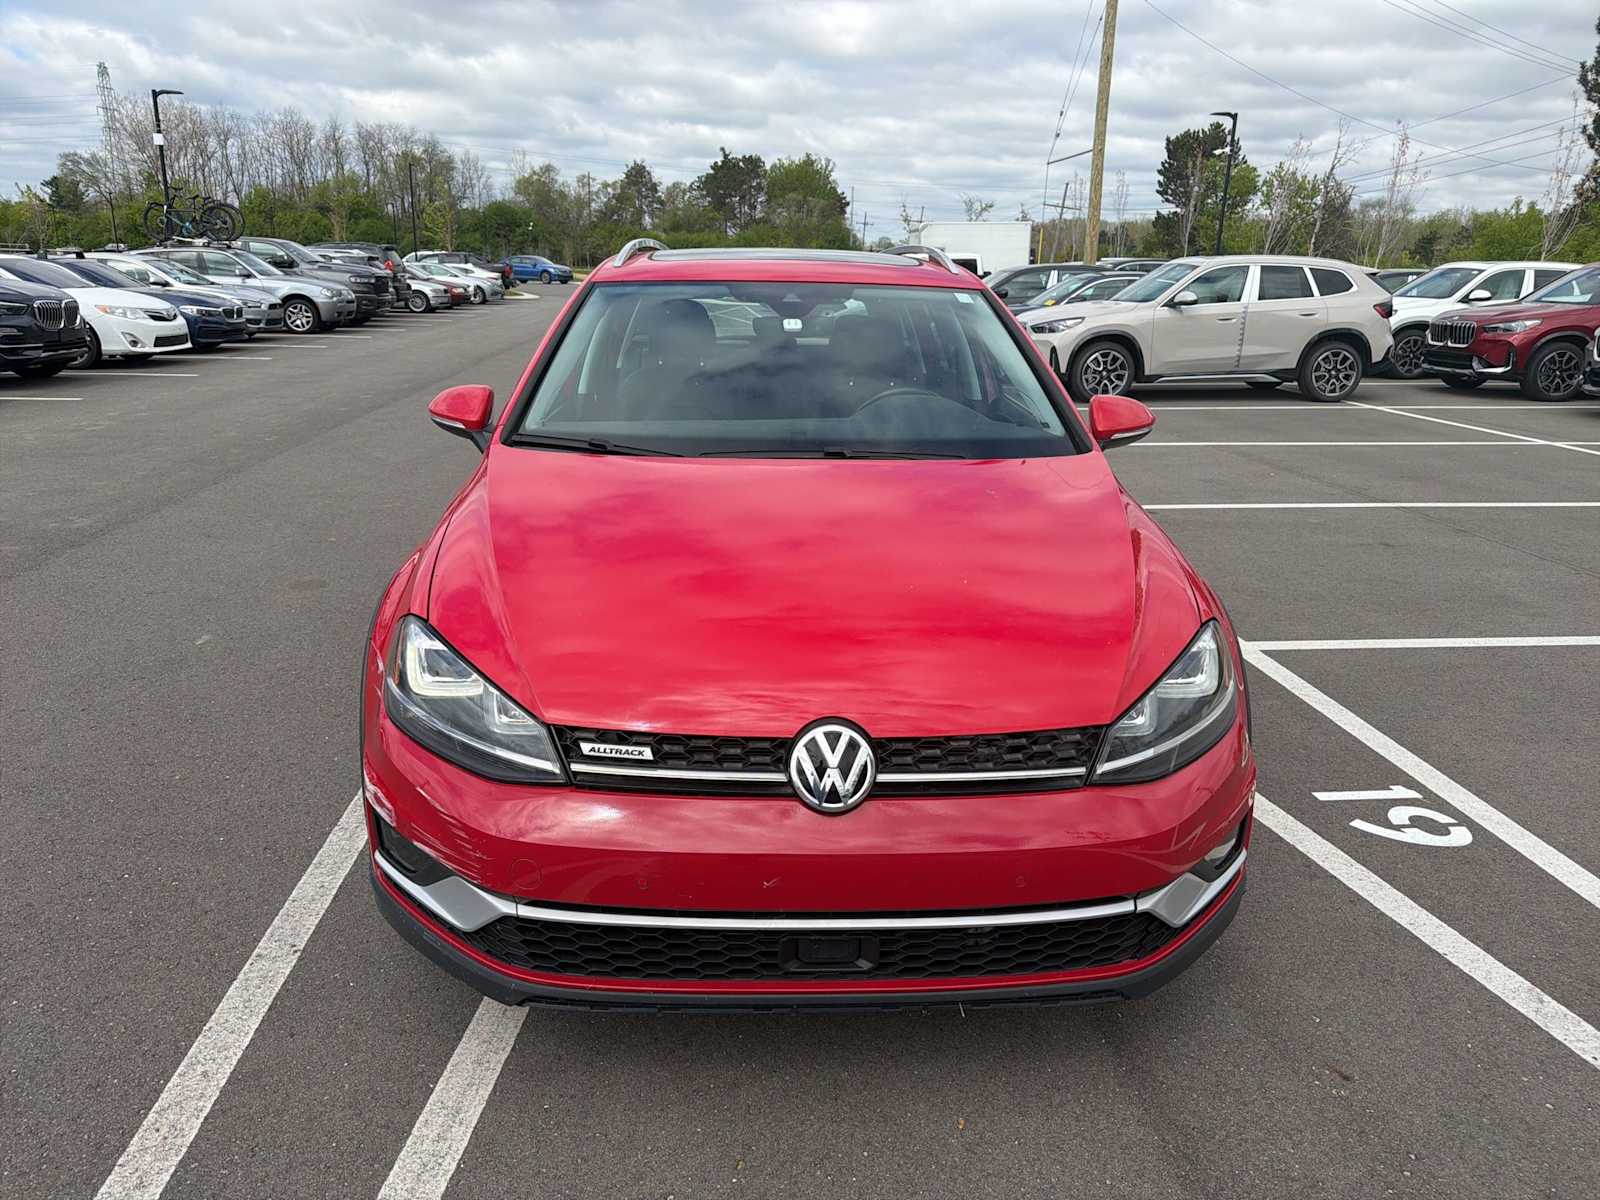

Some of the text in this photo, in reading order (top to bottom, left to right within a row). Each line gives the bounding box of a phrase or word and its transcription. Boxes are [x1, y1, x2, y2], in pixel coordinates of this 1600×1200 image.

[588, 746, 645, 757] ALLTRACK
[790, 723, 876, 808] VW
[1311, 785, 1473, 847] 19
